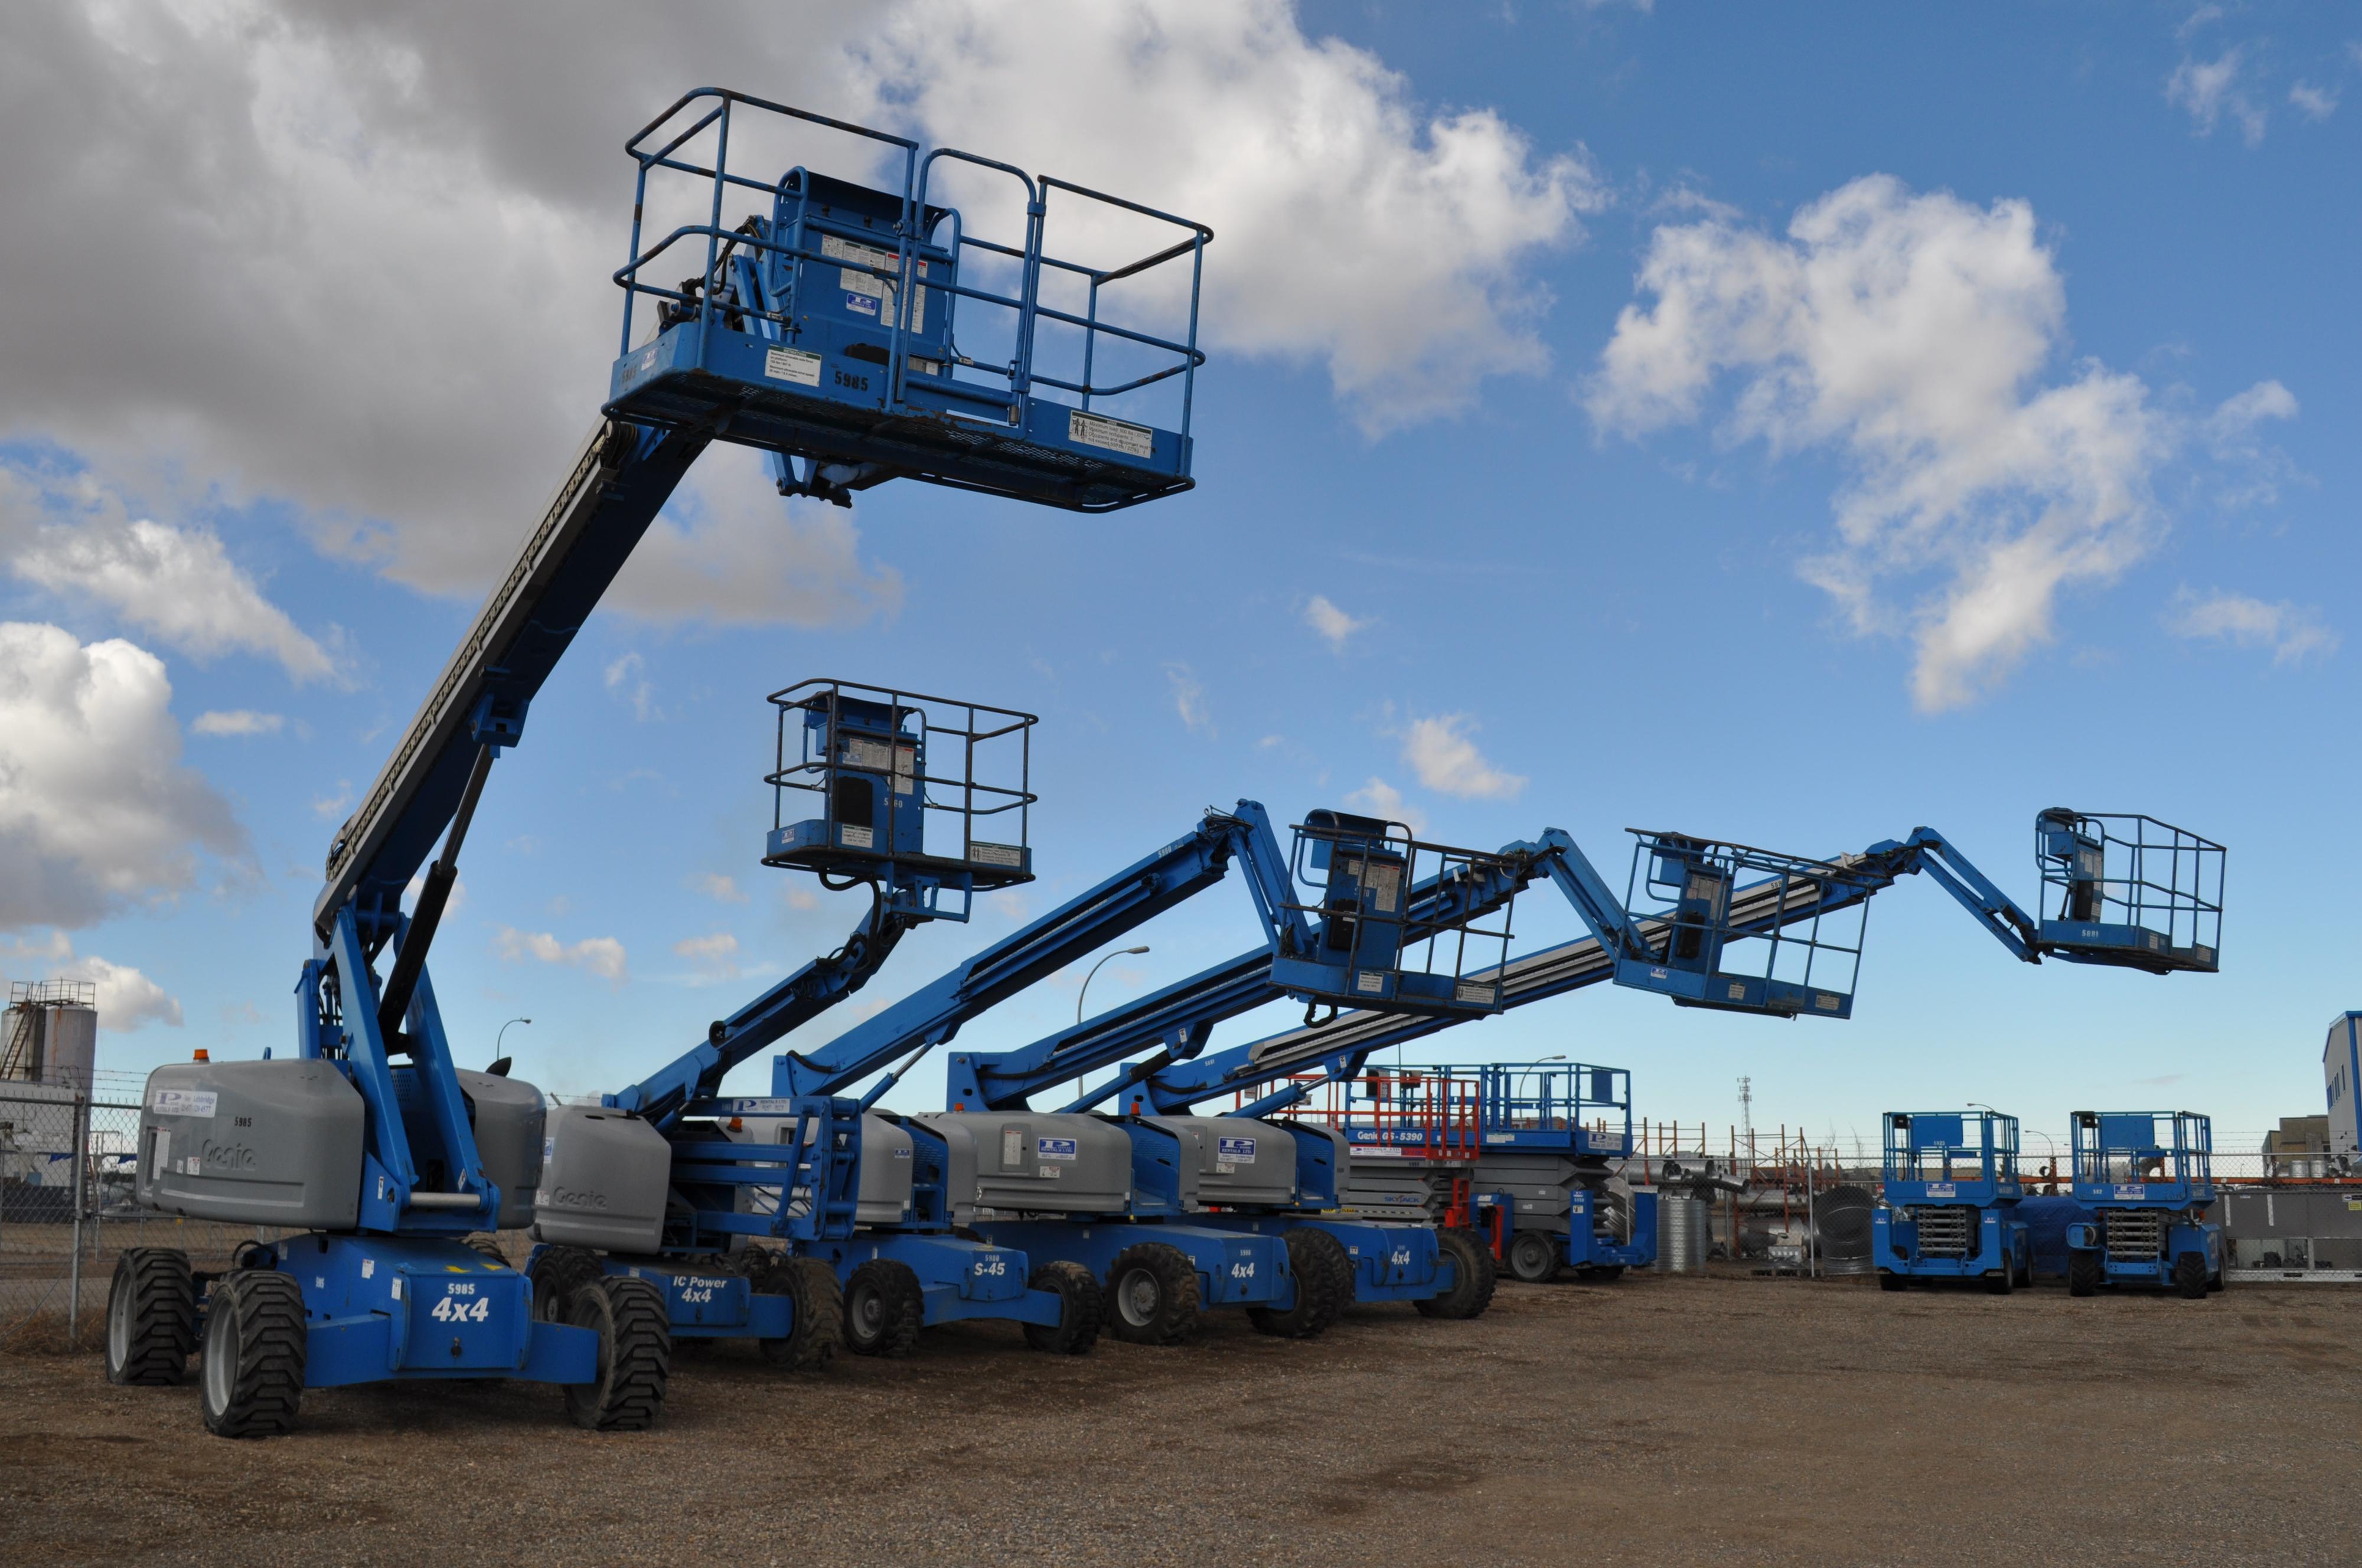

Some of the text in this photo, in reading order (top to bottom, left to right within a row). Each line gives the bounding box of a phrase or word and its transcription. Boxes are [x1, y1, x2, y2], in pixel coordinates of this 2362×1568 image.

[835, 371, 869, 391] 5985
[1089, 421, 1108, 430] Maximum
[1089, 427, 1108, 436] Maximum
[1089, 432, 1110, 440] Occupants
[884, 798, 903, 808] 560
[1158, 845, 1172, 858] 5980
[234, 1117, 252, 1126] 5985
[203, 1139, 256, 1171] Genie
[554, 1186, 606, 1210] Genie
[1391, 1250, 1410, 1265] 4x4
[974, 1262, 1006, 1276] S-45
[1231, 1262, 1255, 1278] 4x4
[673, 1275, 728, 1288] IC Power
[448, 1283, 475, 1295] 5985
[681, 1287, 712, 1303] 4x4
[432, 1296, 489, 1322] 4x4
